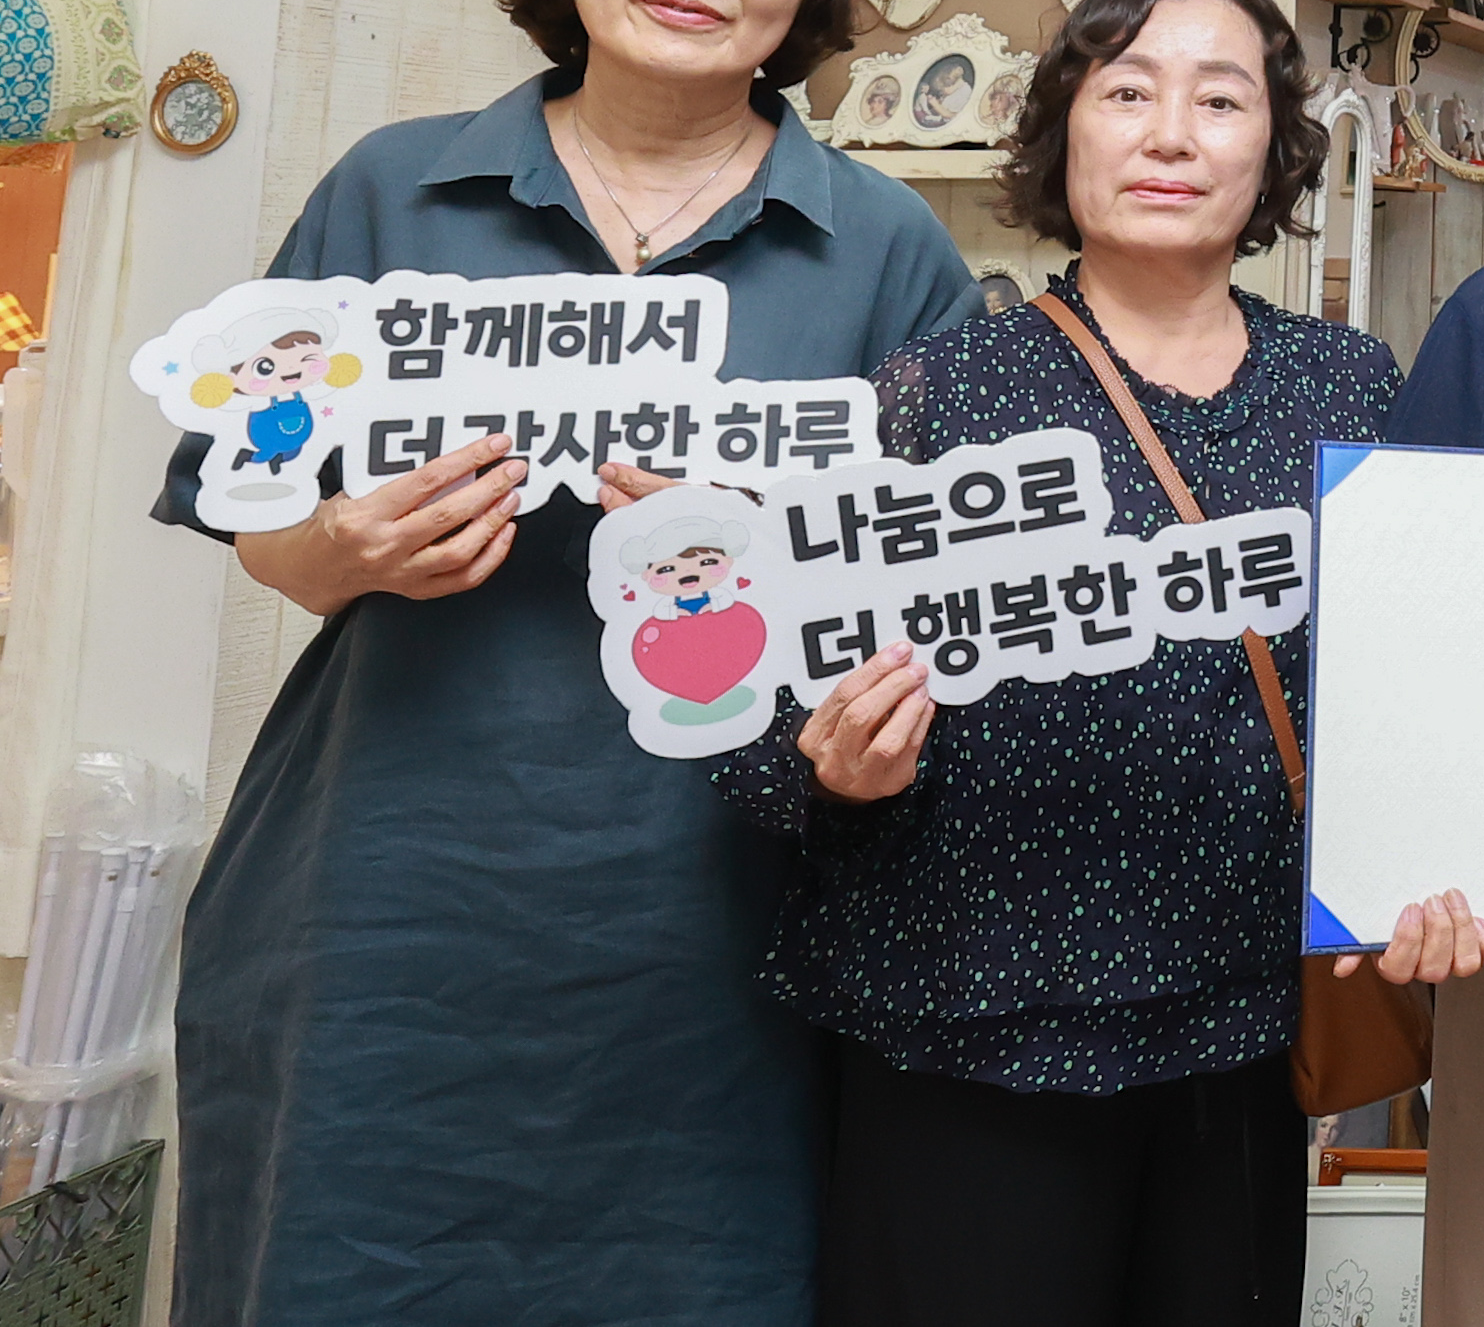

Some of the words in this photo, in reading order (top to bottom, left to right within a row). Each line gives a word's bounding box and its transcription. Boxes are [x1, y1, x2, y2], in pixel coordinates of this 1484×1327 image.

[375, 299, 700, 380] 함께해서
[367, 415, 445, 477] 더
[714, 397, 855, 469] 하루
[787, 458, 1087, 566] 나눔으로
[800, 615, 875, 683] 더
[900, 564, 1136, 679] 행복한
[1158, 535, 1303, 619] 하루
